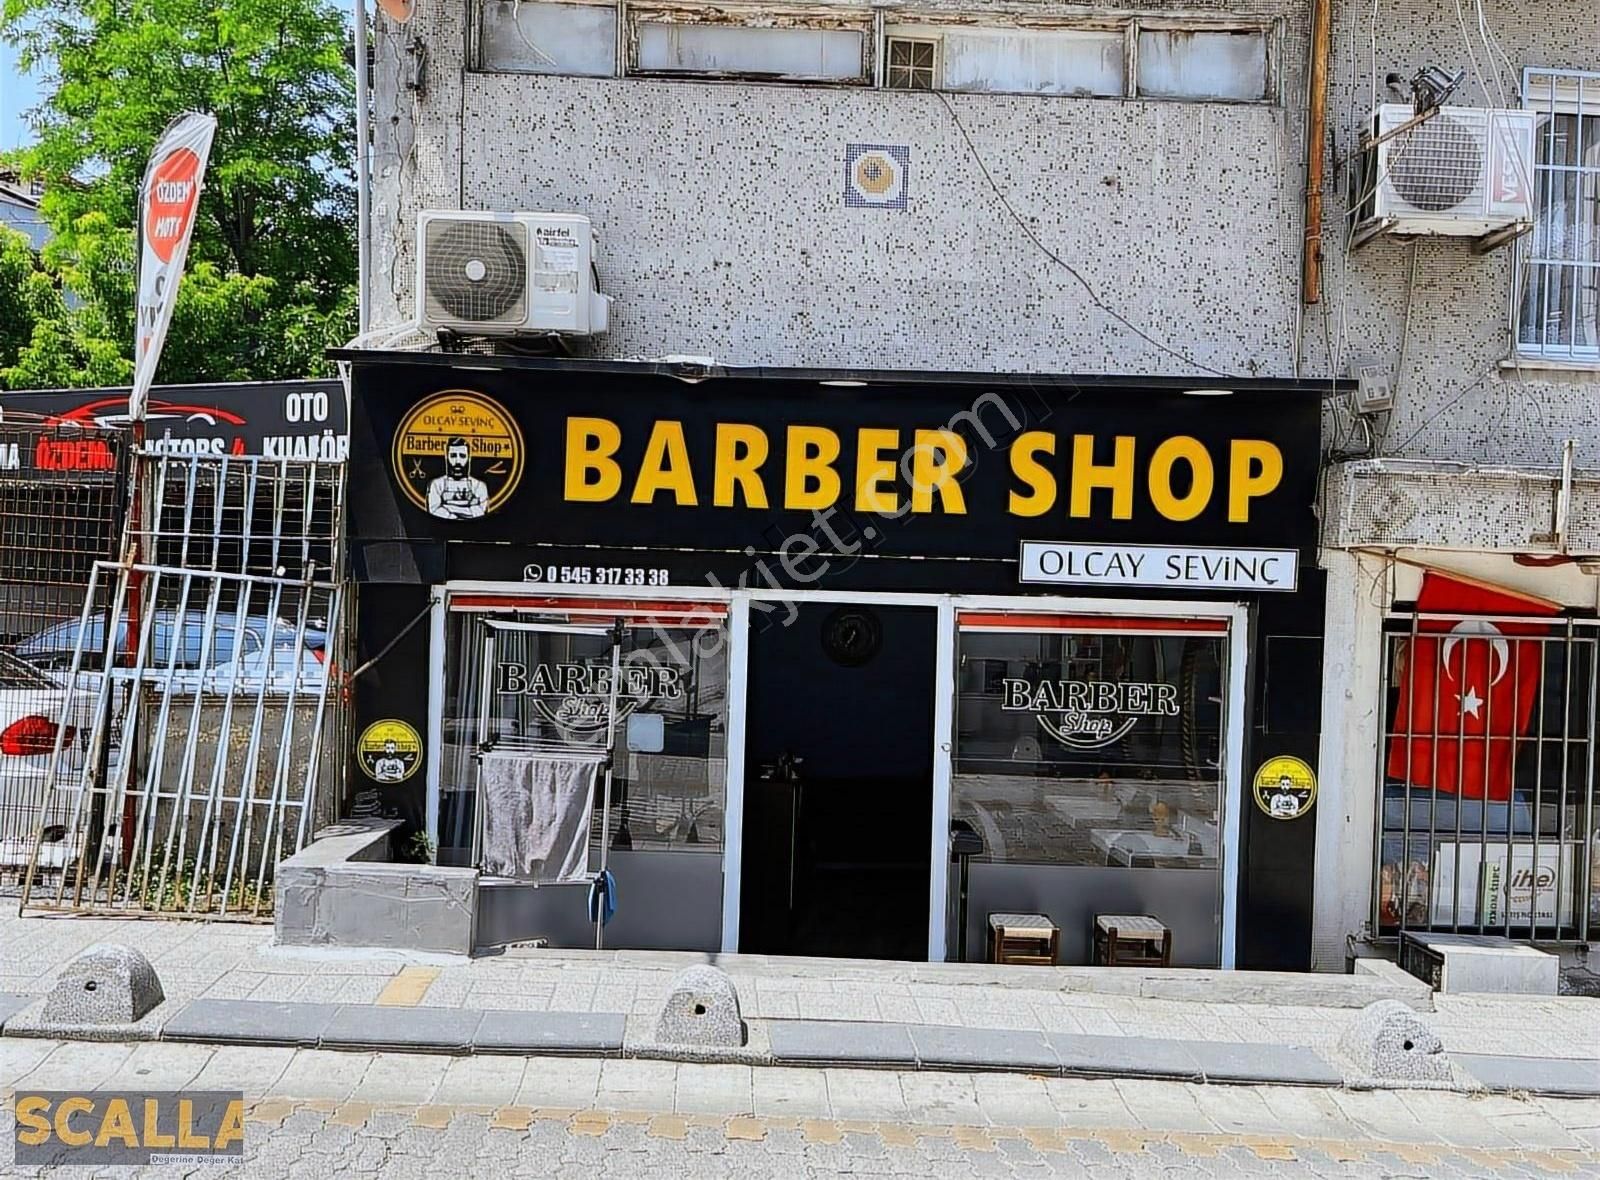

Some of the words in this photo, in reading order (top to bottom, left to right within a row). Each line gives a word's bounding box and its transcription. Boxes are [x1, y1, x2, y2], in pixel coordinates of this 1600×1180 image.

[156, 178, 194, 203] ÖZDEM
[286, 392, 328, 422] OTO
[423, 415, 457, 427] OLCAY
[36, 436, 113, 470] ÖZDEM
[406, 436, 447, 452] Barber
[471, 438, 502, 457] Shop
[563, 416, 968, 515] BARBER
[1008, 430, 1284, 523] SHOP
[546, 566, 557, 582] 0
[560, 566, 592, 584] 545
[595, 567, 622, 585] 317
[624, 568, 645, 585] 33
[648, 569, 669, 586] 38
[1039, 549, 1146, 578] OLCAY
[497, 661, 682, 700] BARBER
[556, 696, 613, 724] Shop
[1001, 678, 1180, 716] BARBER
[1060, 711, 1113, 741] Shop
[1512, 869, 1550, 888] ihe
